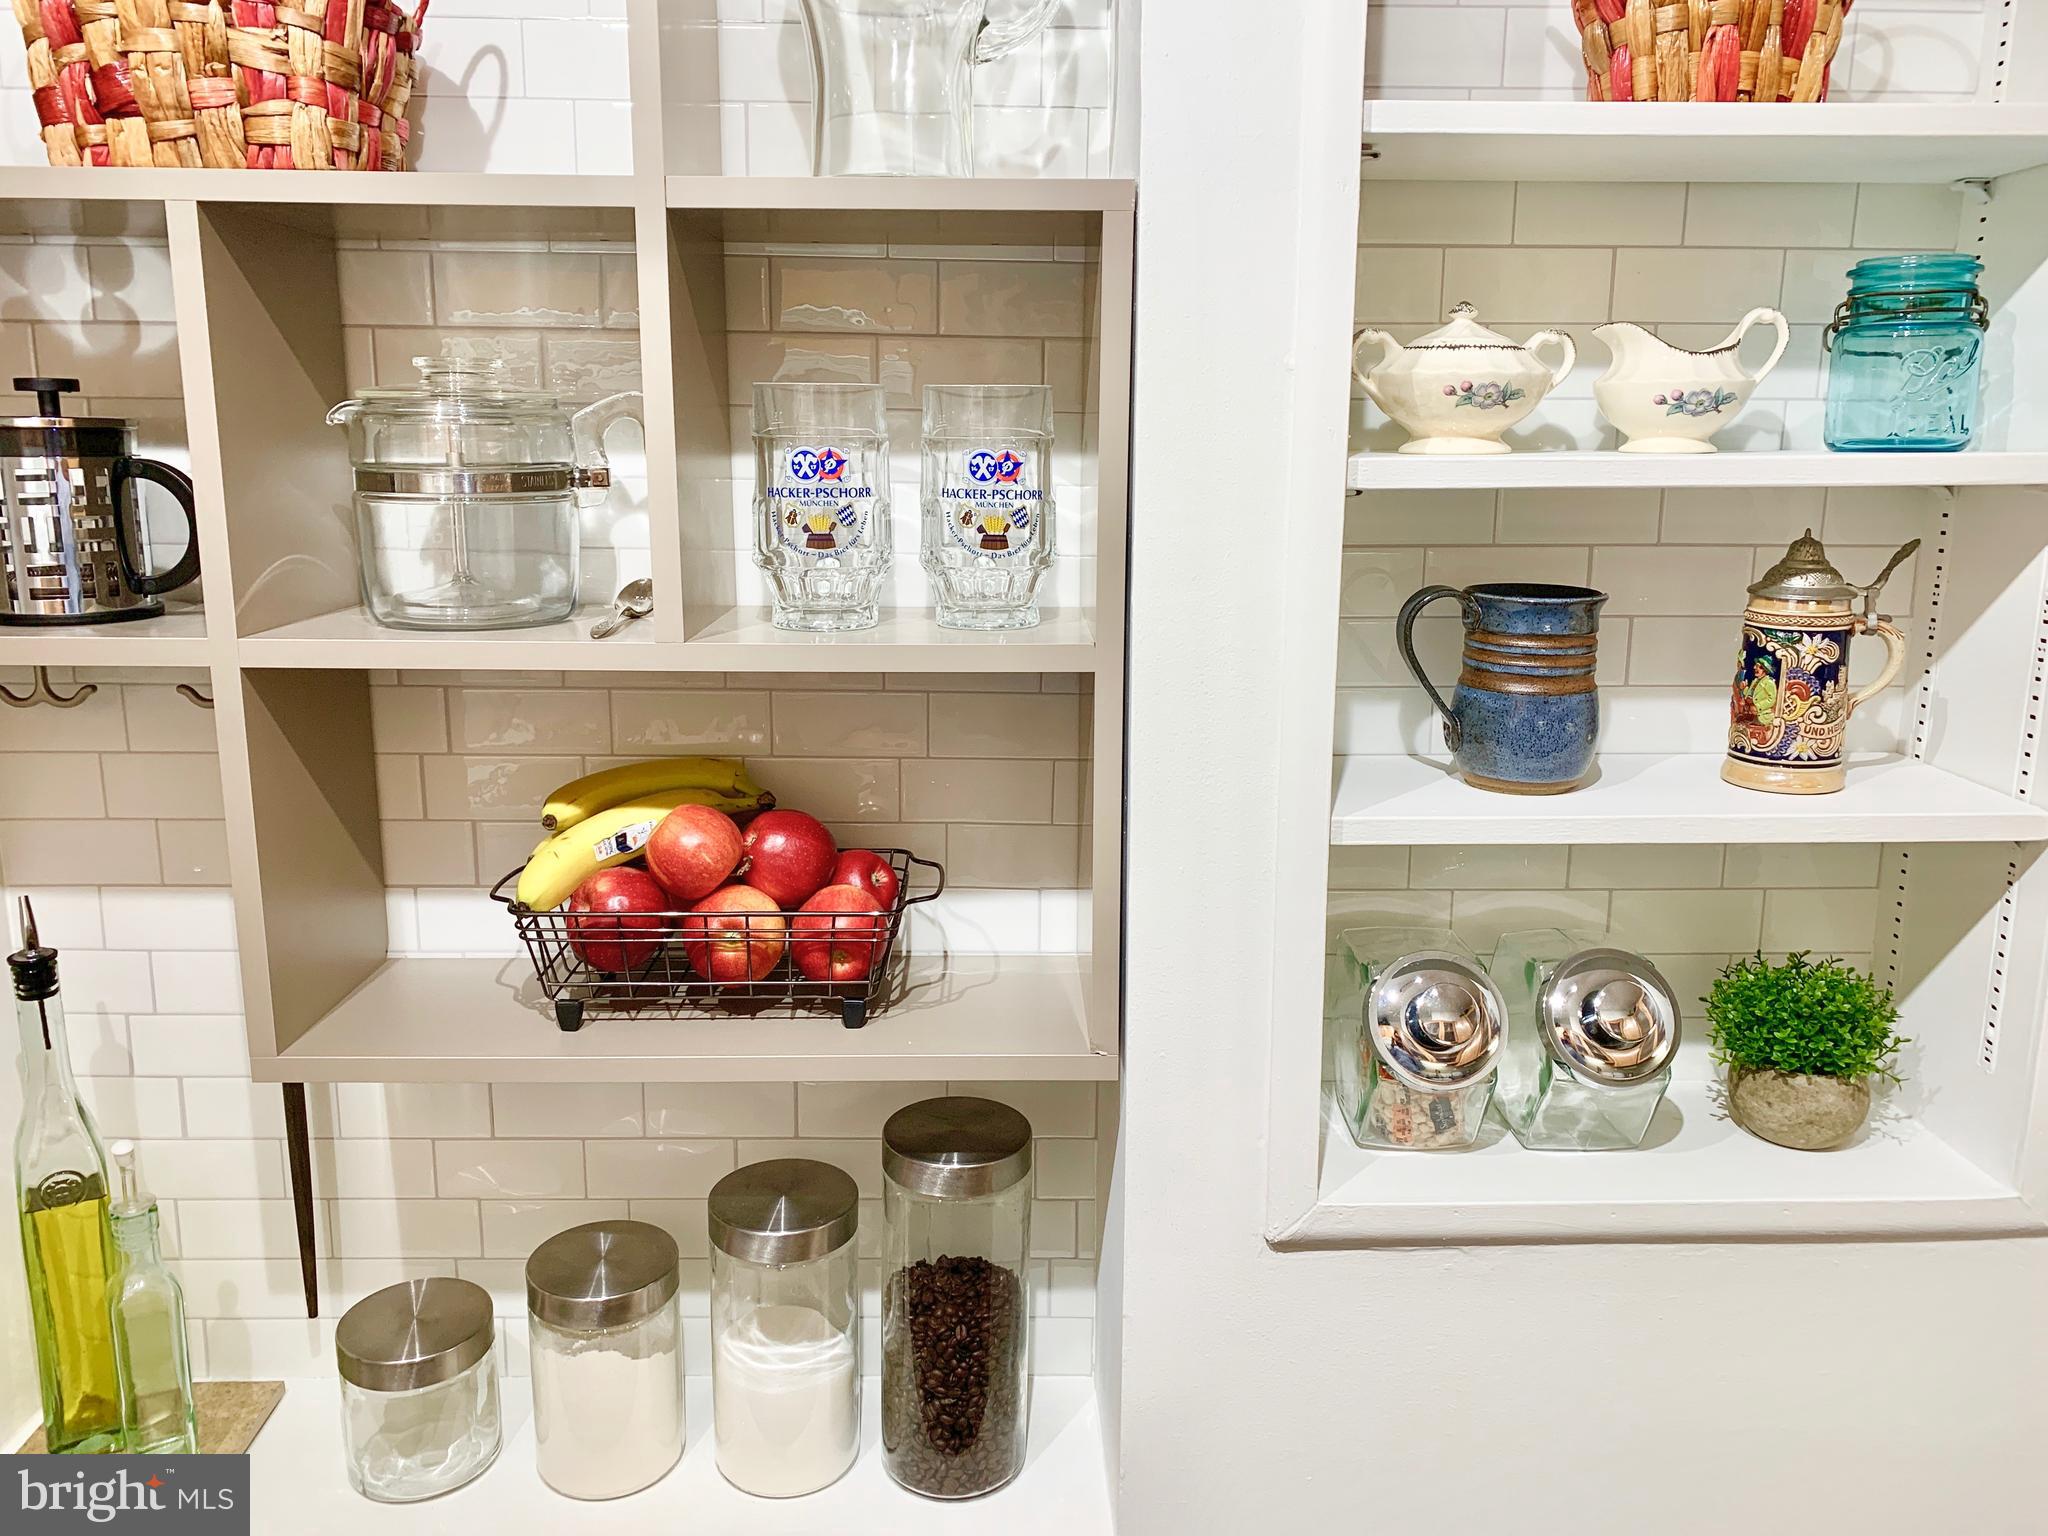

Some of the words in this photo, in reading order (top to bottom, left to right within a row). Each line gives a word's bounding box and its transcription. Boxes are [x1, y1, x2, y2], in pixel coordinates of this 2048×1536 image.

[767, 486, 872, 498] HACKER-PSCHORR
[941, 487, 1043, 500] HACKER-PSCHORR
[799, 499, 839, 507] MÜNCHEN
[975, 500, 1014, 509] MÜNCHEN
[1803, 725, 1826, 736] UND
